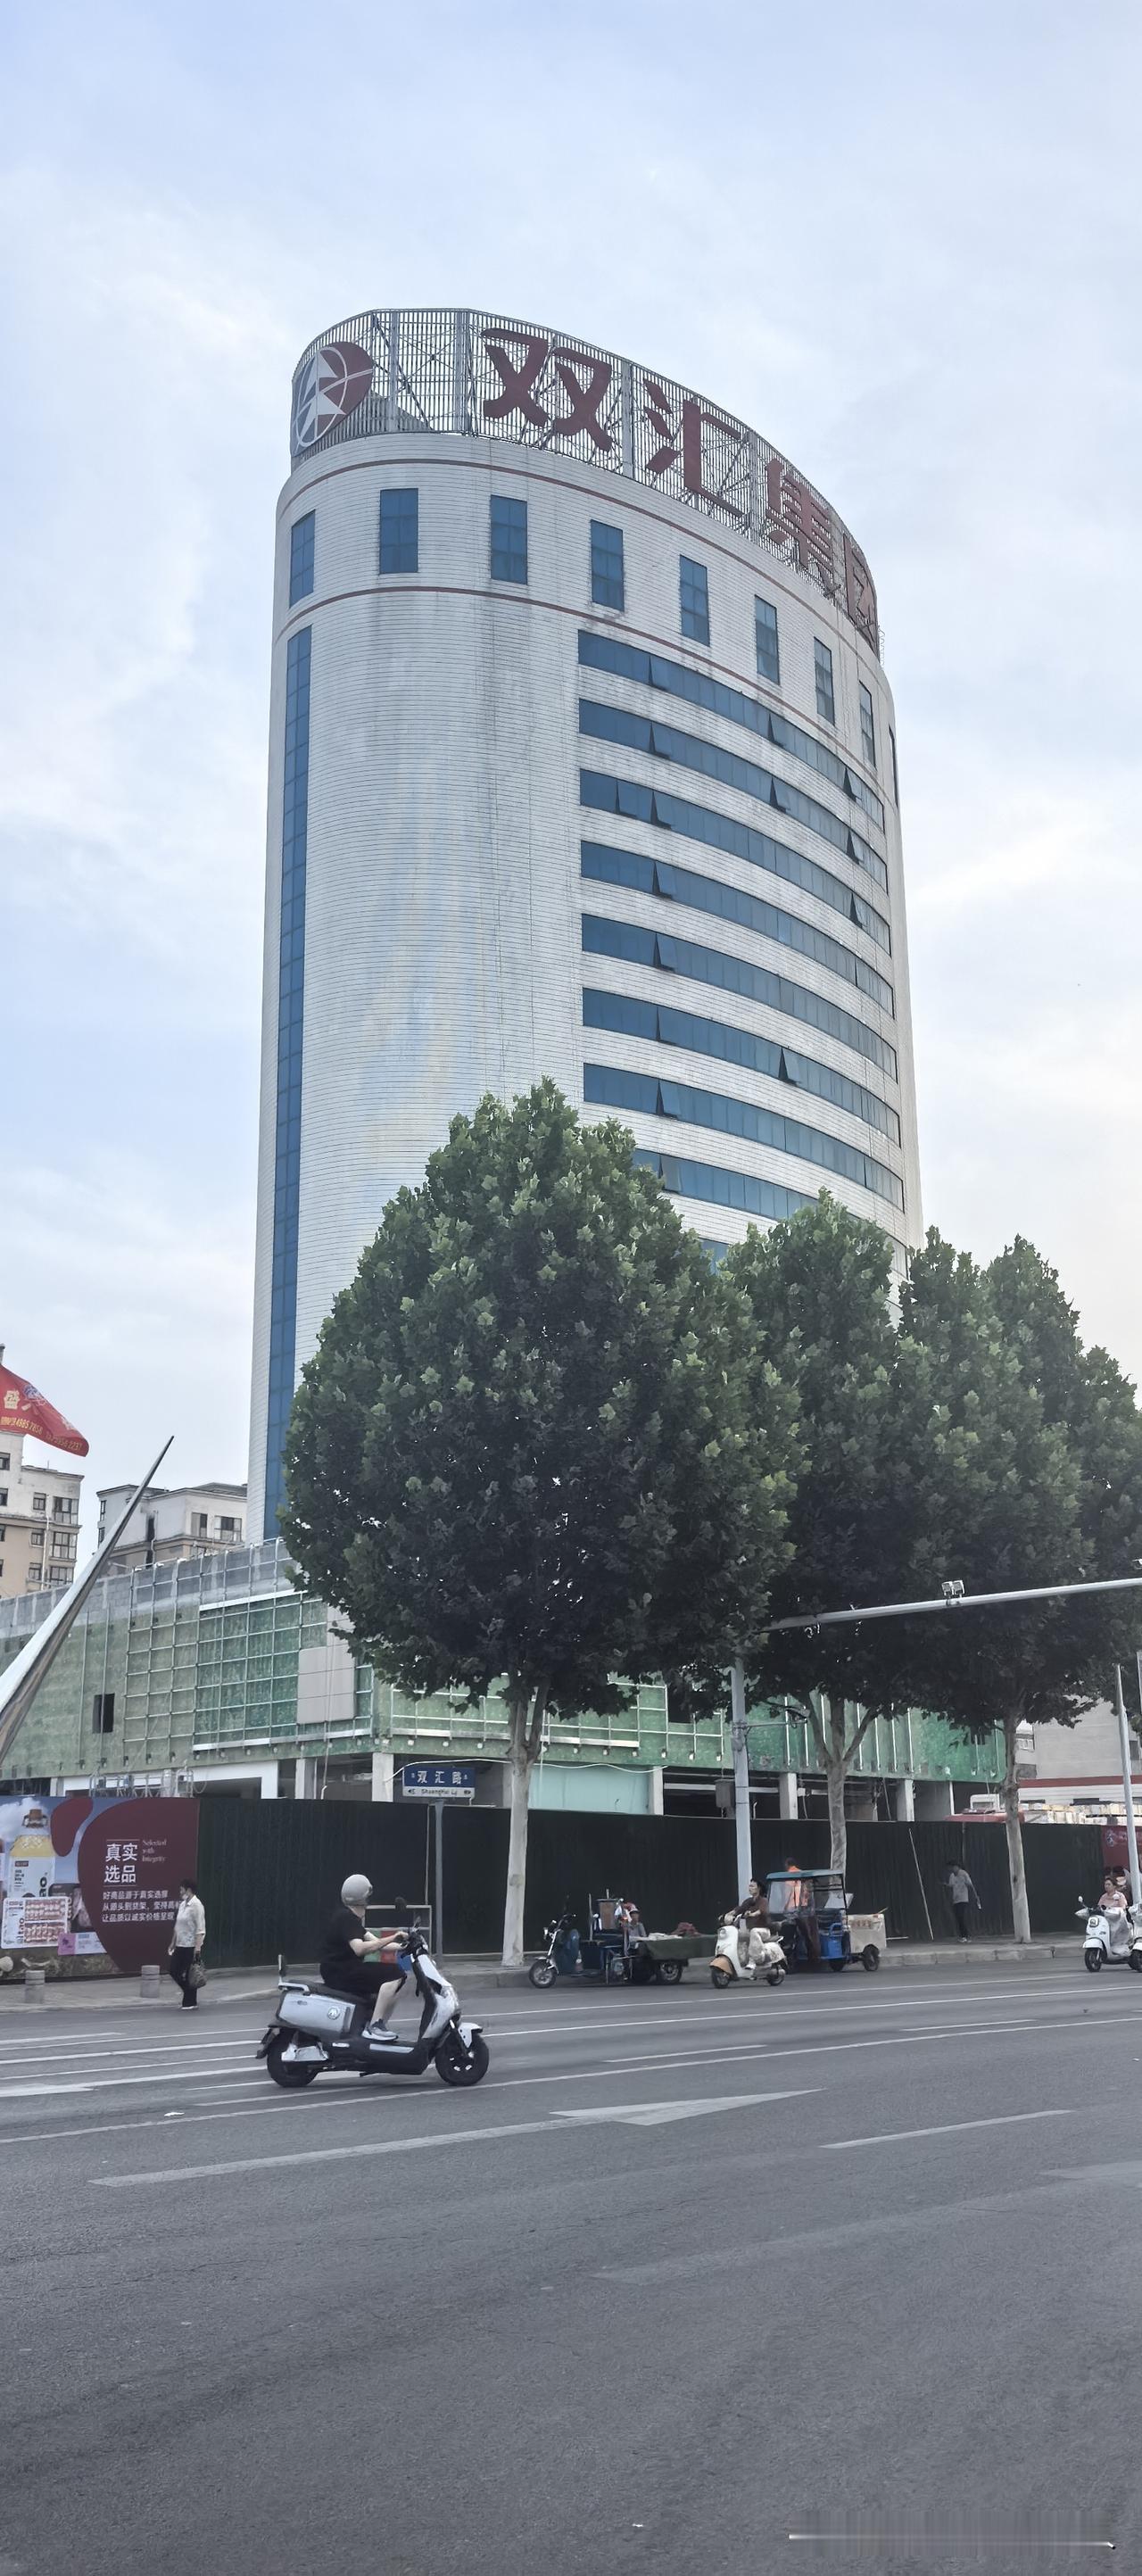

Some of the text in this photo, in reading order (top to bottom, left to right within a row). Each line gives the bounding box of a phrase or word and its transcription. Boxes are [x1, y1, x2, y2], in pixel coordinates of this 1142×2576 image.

[482, 327, 880, 658] 双汇集团
[417, 1770, 462, 1785] 双汇路
[105, 1843, 138, 1862] 真实
[103, 1864, 137, 1883] 选品
